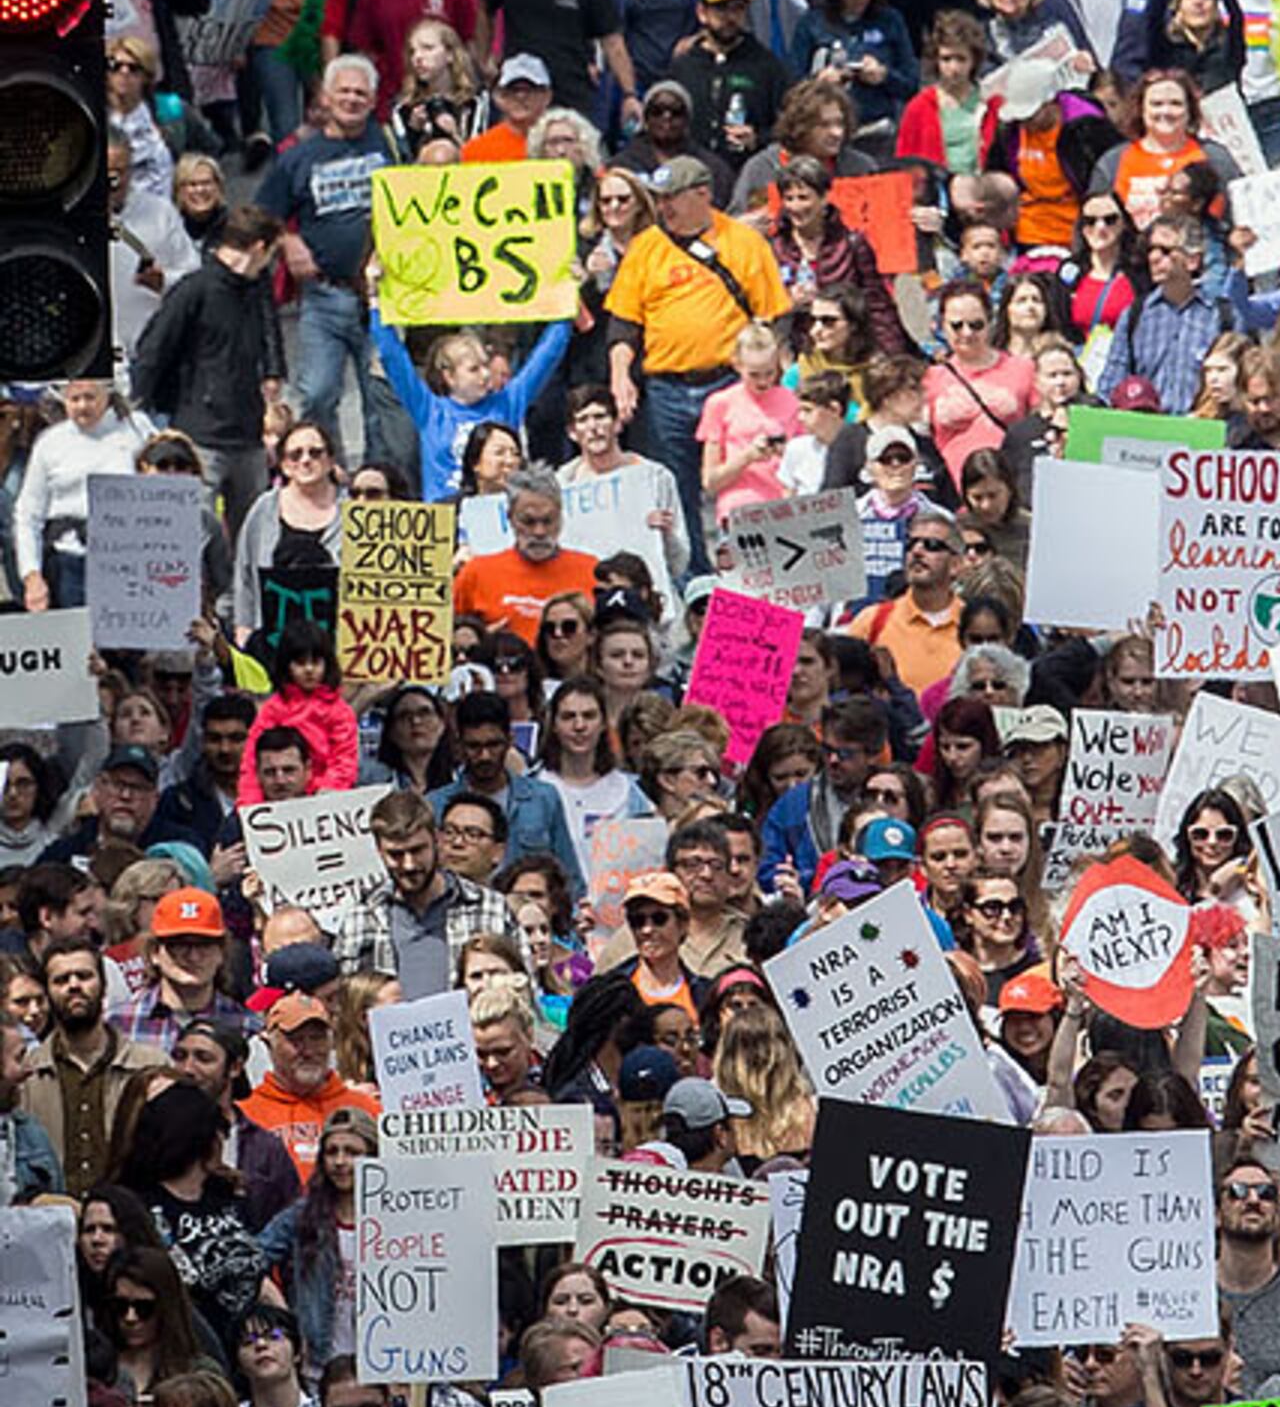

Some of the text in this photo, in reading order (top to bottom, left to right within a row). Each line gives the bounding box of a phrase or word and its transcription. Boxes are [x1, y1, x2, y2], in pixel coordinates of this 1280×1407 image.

[381, 175, 458, 227] We
[453, 236, 539, 303] BS
[345, 509, 450, 545] SCHOOL
[355, 543, 435, 576] ZONE
[1176, 588, 1241, 614] NOT
[341, 611, 436, 644] WAR
[344, 645, 446, 682] ZONE!
[810, 944, 860, 984] NRA
[1089, 925, 1174, 973] NEXT?
[389, 1020, 456, 1049] CHANGE
[818, 981, 921, 1051] TERRORIST
[383, 1043, 469, 1075] GUN LAWS
[824, 995, 966, 1087] ORGANIZATION
[380, 1105, 540, 1138] CHILDREN
[361, 1164, 461, 1214] PROTECT
[868, 1154, 969, 1198] VOTE
[833, 1198, 991, 1251] OUT THE
[358, 1265, 442, 1314] NOT
[1032, 1292, 1119, 1331] EARTH
